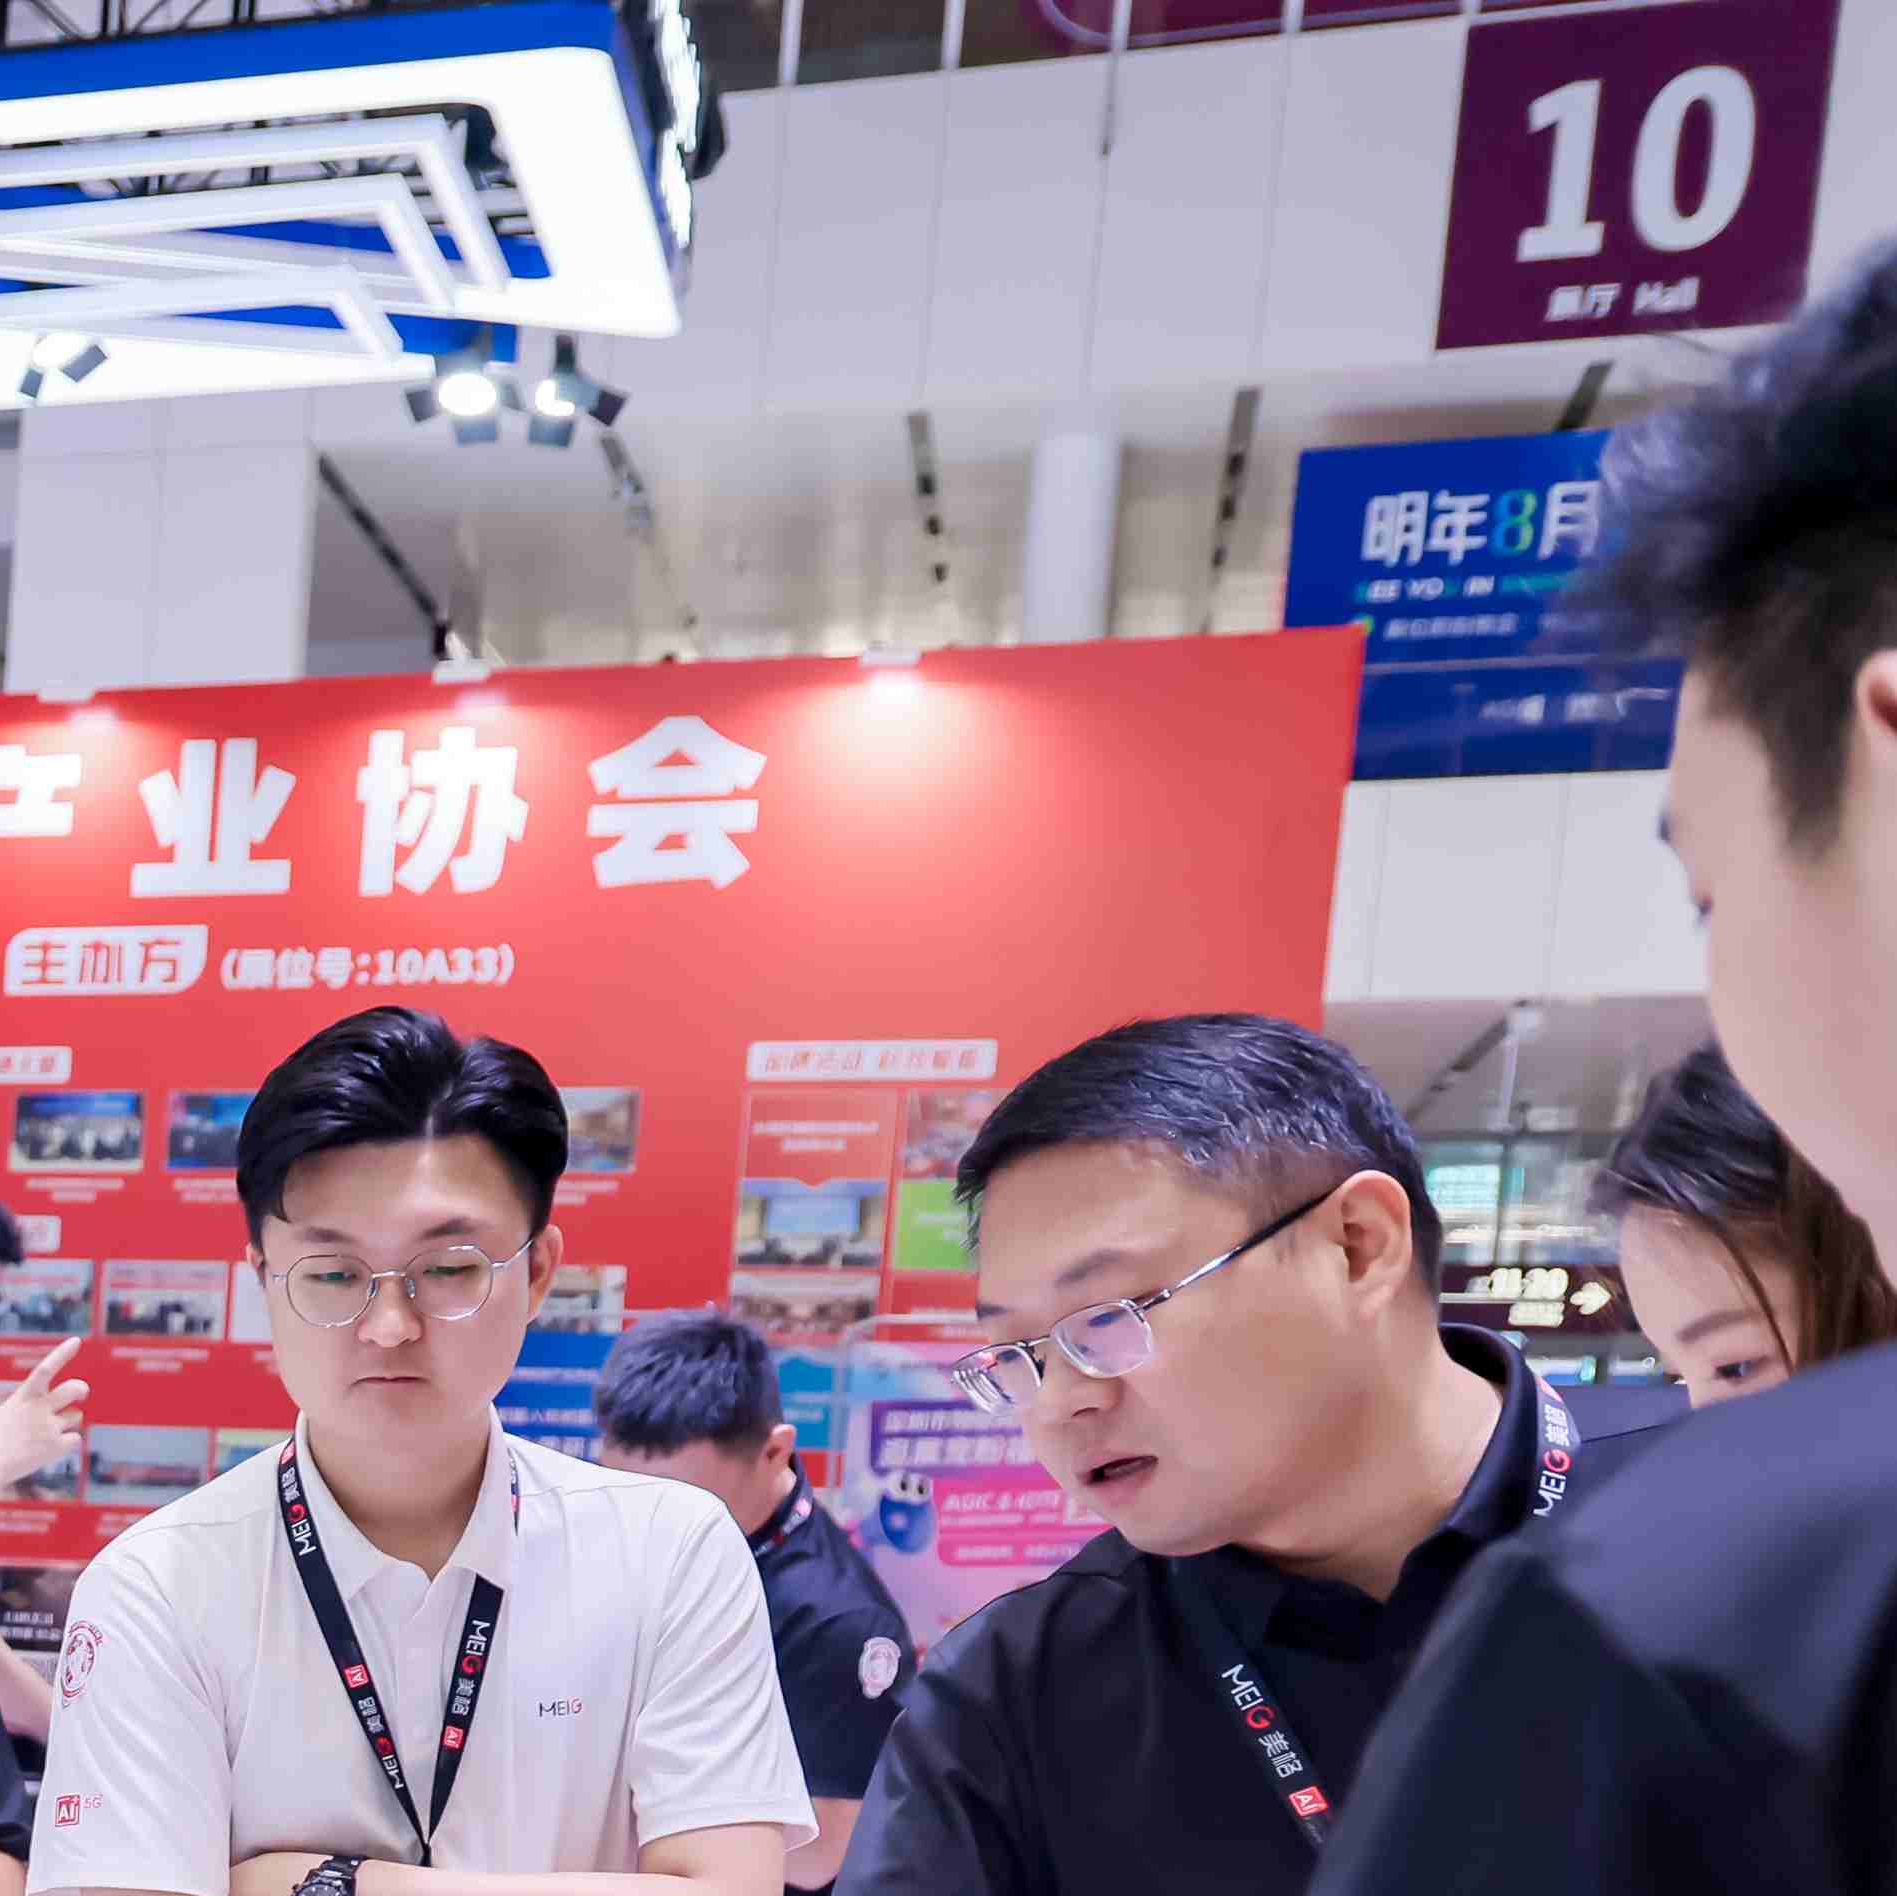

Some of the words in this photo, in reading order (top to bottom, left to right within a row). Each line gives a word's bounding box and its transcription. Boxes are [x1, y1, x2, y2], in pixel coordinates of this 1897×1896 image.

[1516, 64, 1757, 263] 10
[286, 1503, 317, 1556] MEIG
[461, 1620, 491, 1675] MEIG
[538, 1699, 584, 1719] MEIG
[1221, 1664, 1276, 1729] MEIG
[1258, 1730, 1304, 1778] 美格
[376, 1737, 405, 1789] MEIG
